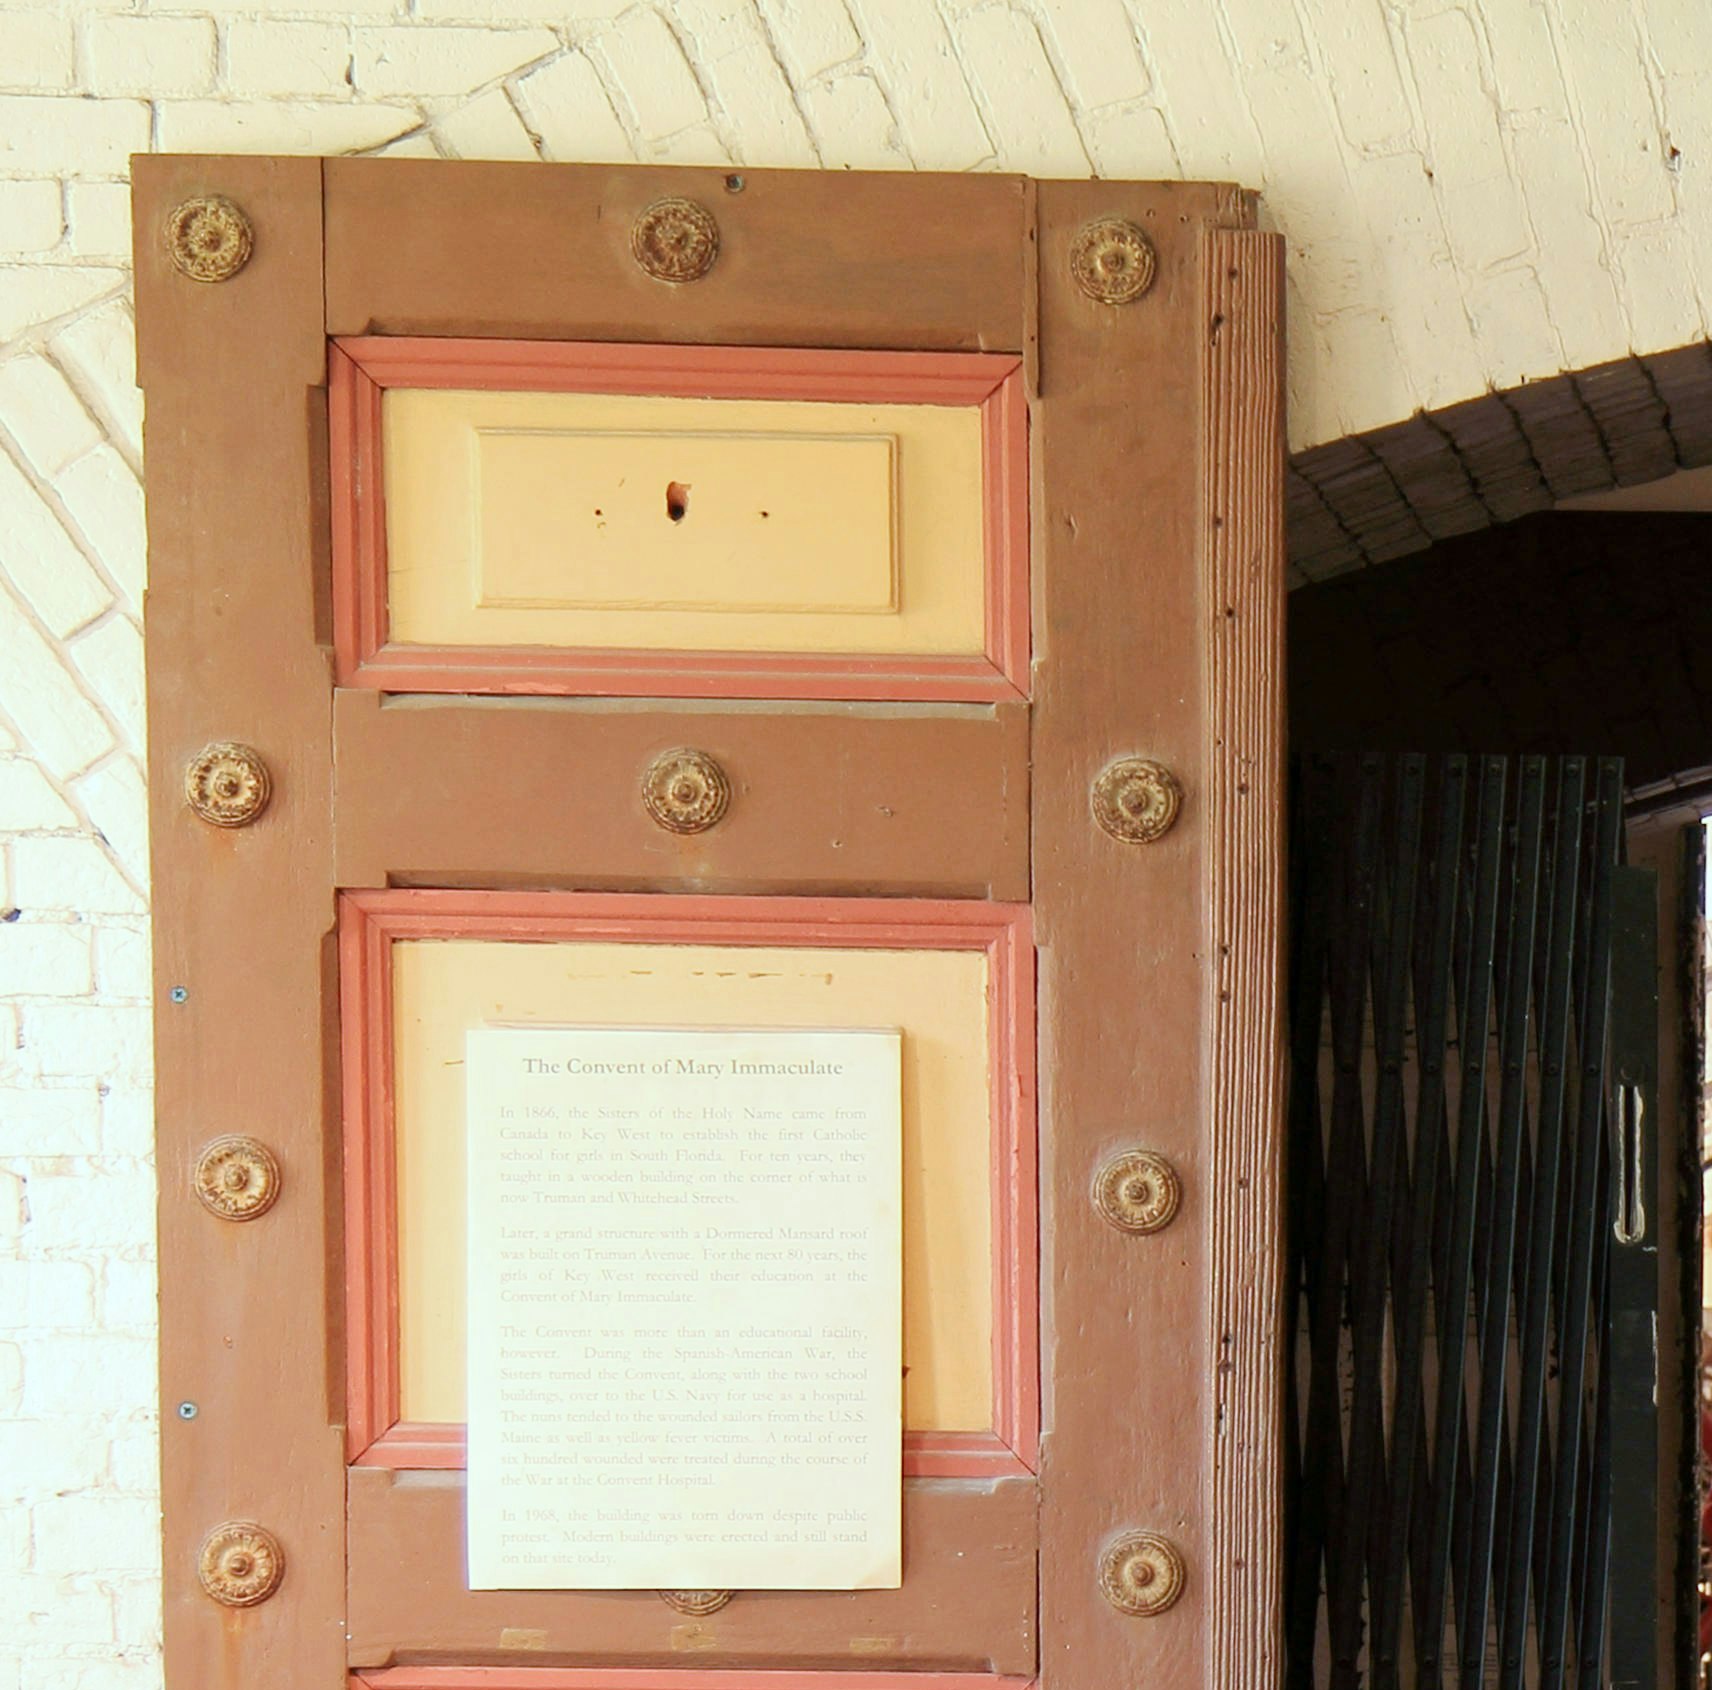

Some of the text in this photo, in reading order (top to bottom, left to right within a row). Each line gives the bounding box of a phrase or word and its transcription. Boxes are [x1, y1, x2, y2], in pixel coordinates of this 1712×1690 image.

[522, 1057, 843, 1080] The Convent of Mary Immaculate
[500, 1105, 515, 1120] In
[567, 1105, 590, 1120] the
[597, 1105, 640, 1120] Sisters
[671, 1105, 693, 1120] the
[701, 1105, 733, 1124] Holy
[742, 1105, 783, 1120] Name
[791, 1110, 825, 1120] came
[834, 1105, 867, 1120] from
[499, 1126, 868, 1145] Canada Key West establish the first Catholic
[499, 1147, 543, 1162] school
[550, 1147, 571, 1162] for
[576, 1147, 604, 1166] girls
[629, 1147, 669, 1162] South
[739, 1147, 764, 1162] For
[769, 1150, 791, 1162] ten
[839, 1147, 866, 1166] they
[499, 1168, 542, 1187] taught
[580, 1168, 634, 1183] wooden
[639, 1168, 694, 1187] building
[722, 1168, 744, 1183] the
[818, 1168, 851, 1183] what
[500, 1194, 529, 1204] now
[532, 1189, 586, 1204] Truman
[589, 1189, 615, 1204] and
[616, 1189, 688, 1204] Whitehead
[555, 1225, 593, 1244] grand
[597, 1228, 656, 1240] structure
[659, 1225, 689, 1240] with
[705, 1225, 774, 1240] Dormered
[778, 1225, 835, 1240] Mansard
[839, 1225, 870, 1240] roof
[499, 1251, 525, 1261] was
[582, 1246, 637, 1261] Truman
[701, 1246, 727, 1261] For
[730, 1246, 752, 1261] the
[754, 1249, 783, 1261] next
[786, 1246, 804, 1261] 80
[846, 1246, 868, 1261] the
[564, 1267, 868, 1286] Key West received their education the
[500, 1288, 558, 1303] Convent
[579, 1288, 612, 1307] Mary
[499, 1323, 527, 1338] The
[535, 1323, 592, 1338] Convent
[599, 1328, 625, 1338] was
[633, 1328, 668, 1338] more
[676, 1323, 706, 1338] than
[738, 1323, 813, 1338] educational
[583, 1344, 632, 1363] During
[846, 1344, 868, 1359] the
[499, 1365, 543, 1380] Sisters
[548, 1365, 592, 1380] turned
[767, 1365, 789, 1380] the
[793, 1368, 820, 1380] two
[824, 1365, 868, 1380] school
[624, 1387, 646, 1402] the
[726, 1387, 747, 1402] for
[752, 1392, 774, 1402] use
[499, 1408, 527, 1423] The
[530, 1413, 563, 1423] nuns
[566, 1408, 611, 1423] tended
[632, 1408, 654, 1423] the
[657, 1408, 718, 1423] wounded
[721, 1408, 763, 1423] sailors
[767, 1408, 800, 1423] from
[803, 1408, 825, 1423] the
[500, 1429, 542, 1444] Maine
[616, 1429, 659, 1448] yellow
[765, 1429, 777, 1444] A
[783, 1429, 813, 1444] total
[837, 1434, 868, 1444] over
[522, 1450, 849, 1469] hundred wounded were treated during the course
[525, 1471, 553, 1486] War
[596, 1471, 653, 1486] Convent
[501, 1507, 516, 1522] In
[596, 1507, 651, 1526] building
[657, 1512, 683, 1522] was
[726, 1507, 765, 1522] down
[772, 1507, 818, 1526] despite
[826, 1507, 868, 1526] public
[562, 1528, 614, 1543] Modern
[619, 1528, 679, 1547] buildings
[683, 1533, 715, 1543] were
[720, 1528, 769, 1543] erected
[773, 1528, 799, 1543] and
[803, 1528, 827, 1543] still
[832, 1528, 868, 1543] stand
